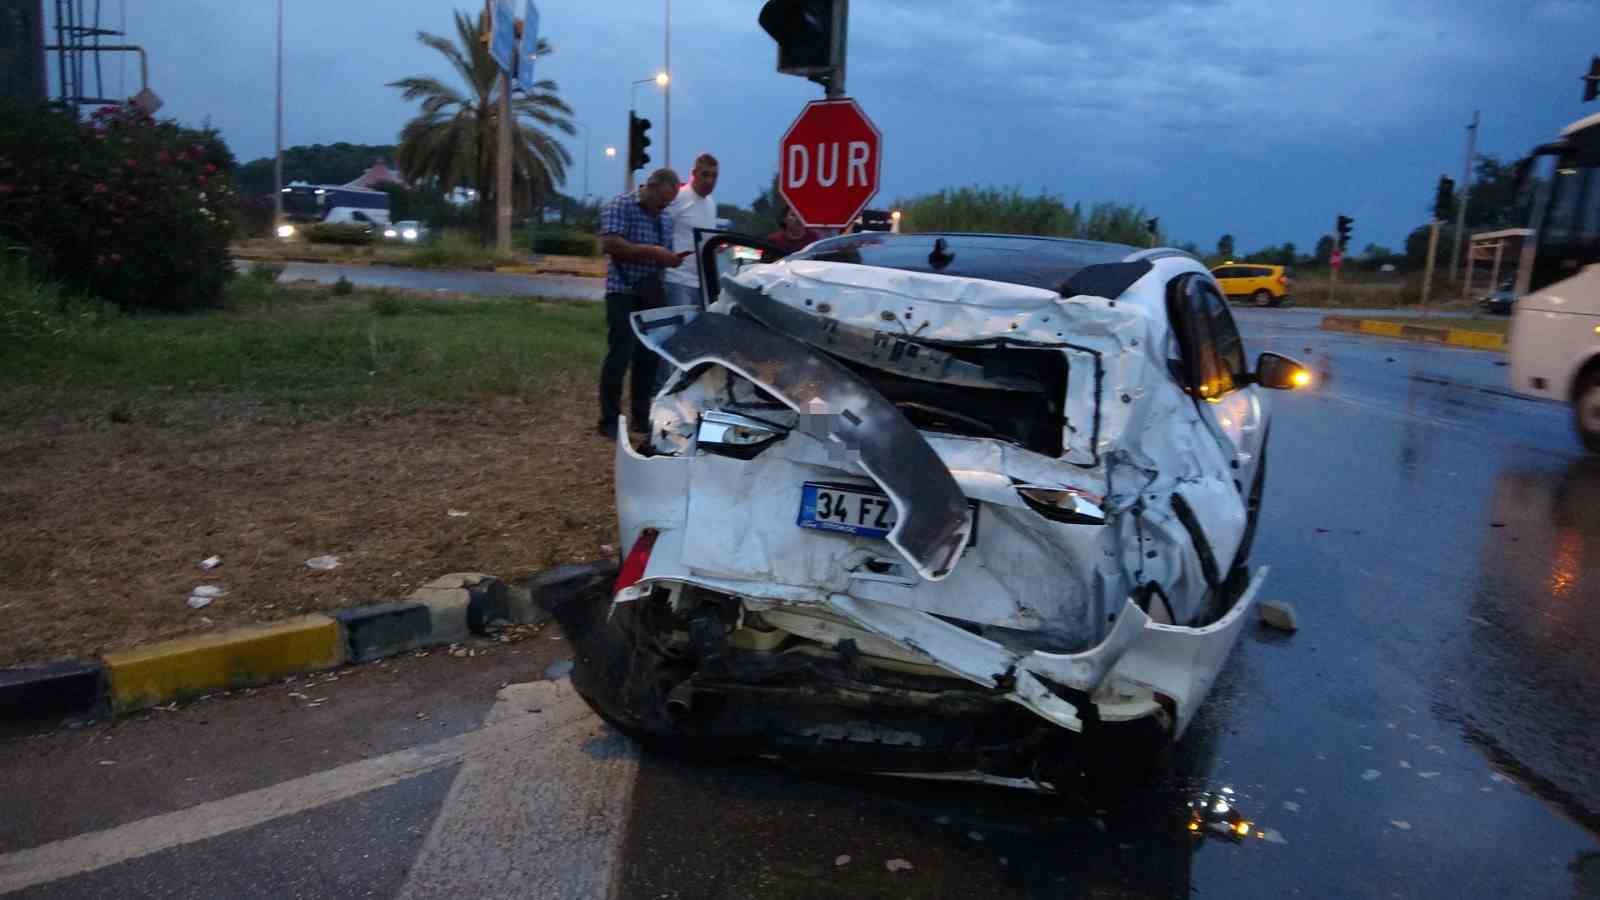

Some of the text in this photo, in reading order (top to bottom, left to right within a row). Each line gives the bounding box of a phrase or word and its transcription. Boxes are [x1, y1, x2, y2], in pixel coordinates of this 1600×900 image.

[788, 141, 870, 188] DUR
[817, 492, 895, 528] 34 FZ
